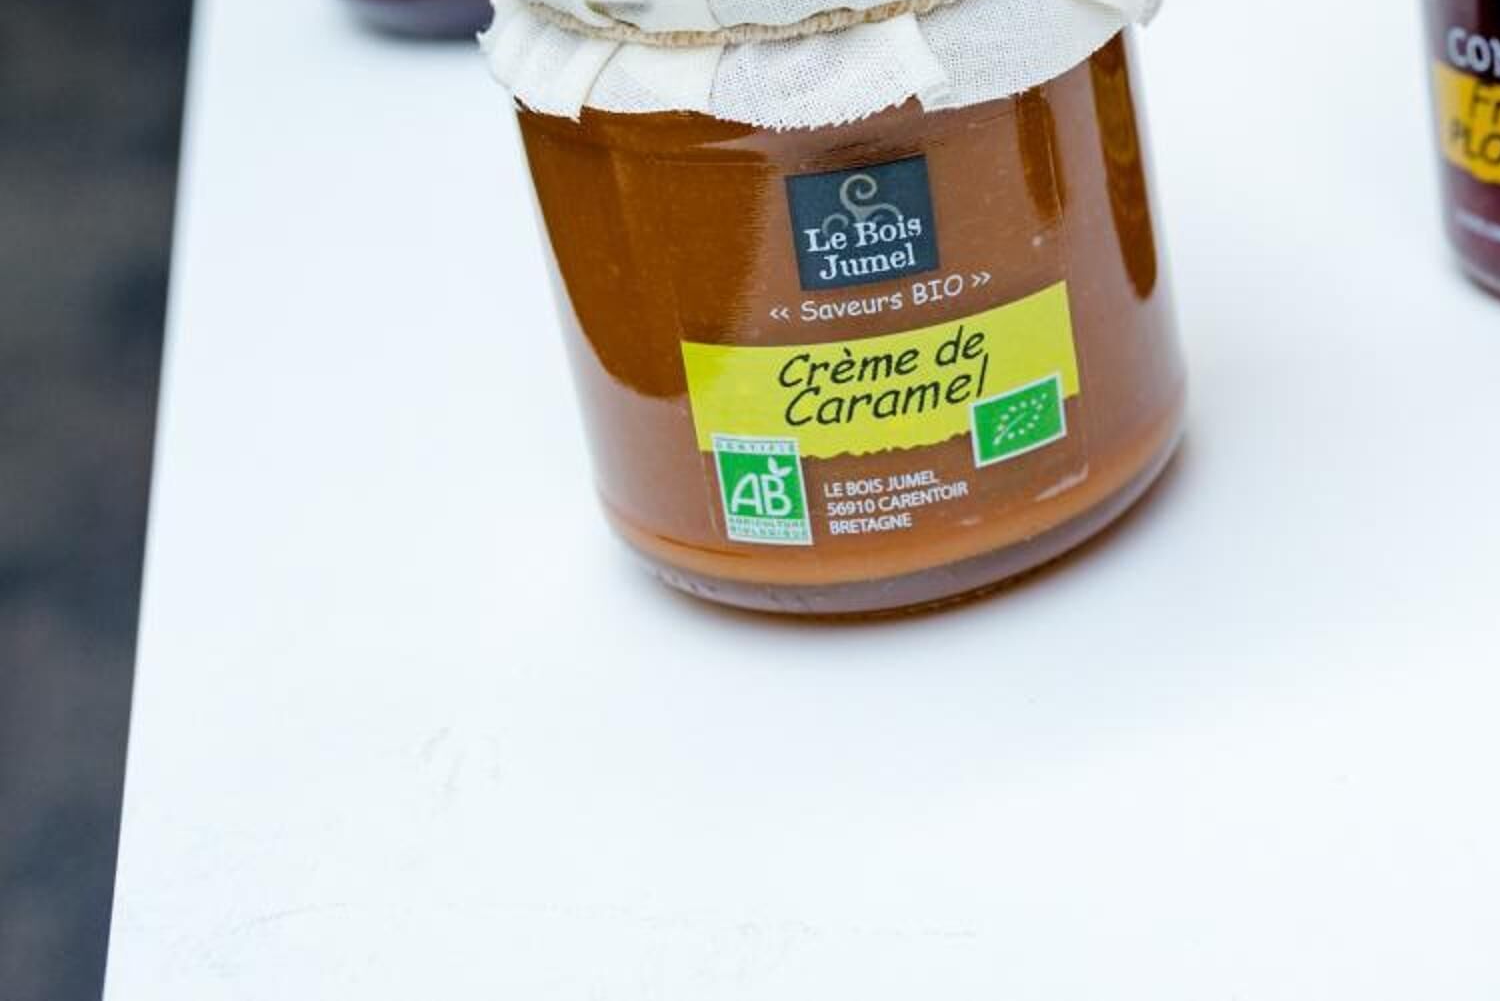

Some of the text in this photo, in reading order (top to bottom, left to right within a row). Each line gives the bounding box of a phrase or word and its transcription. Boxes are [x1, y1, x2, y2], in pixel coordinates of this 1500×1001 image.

[803, 215, 922, 252] Le Bois
[819, 243, 916, 280] Jumel
[801, 293, 903, 321] Saveurs
[912, 274, 963, 304] BIO
[779, 325, 985, 388] Crème de
[785, 353, 989, 426] Caramel
[731, 472, 793, 517] AB
[823, 470, 940, 498] LE BOIS JUMEL
[827, 481, 968, 516] 56910 CARENTOIR
[829, 512, 913, 535] BRETAGNE
